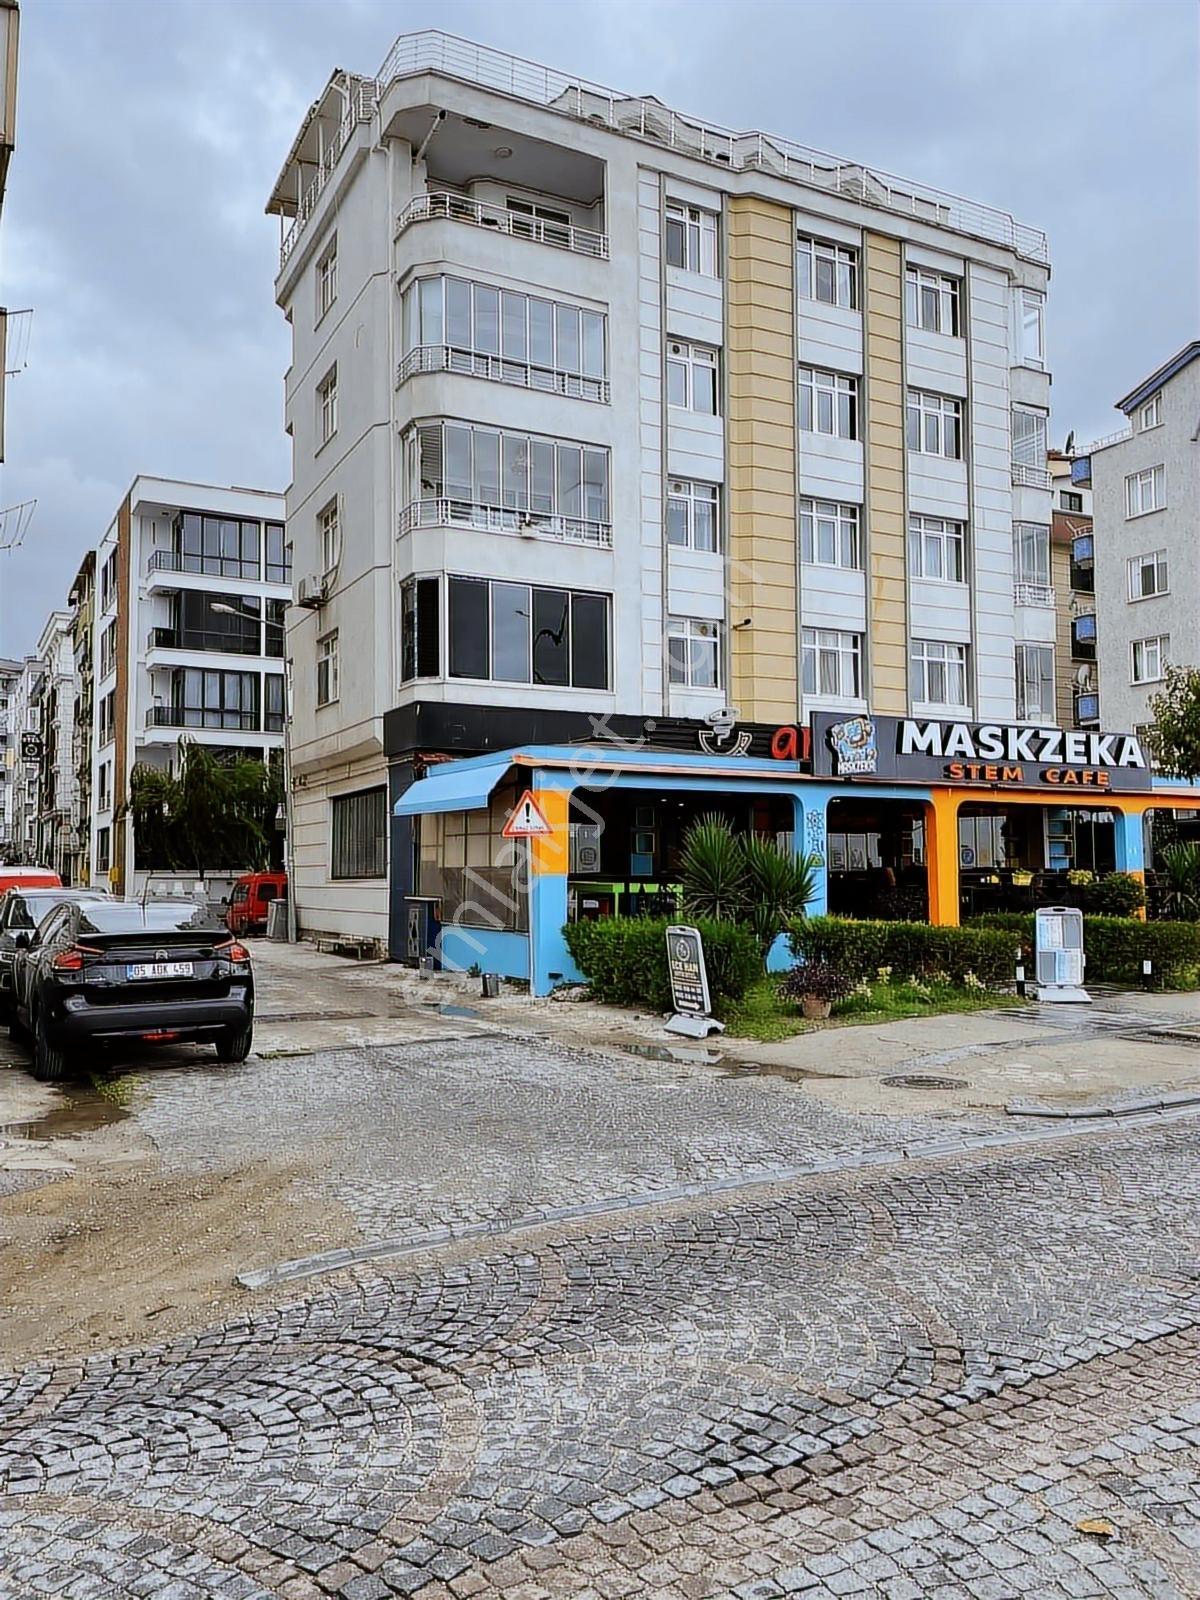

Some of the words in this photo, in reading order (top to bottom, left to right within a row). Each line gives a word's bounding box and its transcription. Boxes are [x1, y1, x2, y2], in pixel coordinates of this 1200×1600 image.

[901, 720, 1146, 768] MASKZEKA
[949, 763, 1025, 783] STEM
[1045, 768, 1111, 786] CAFE
